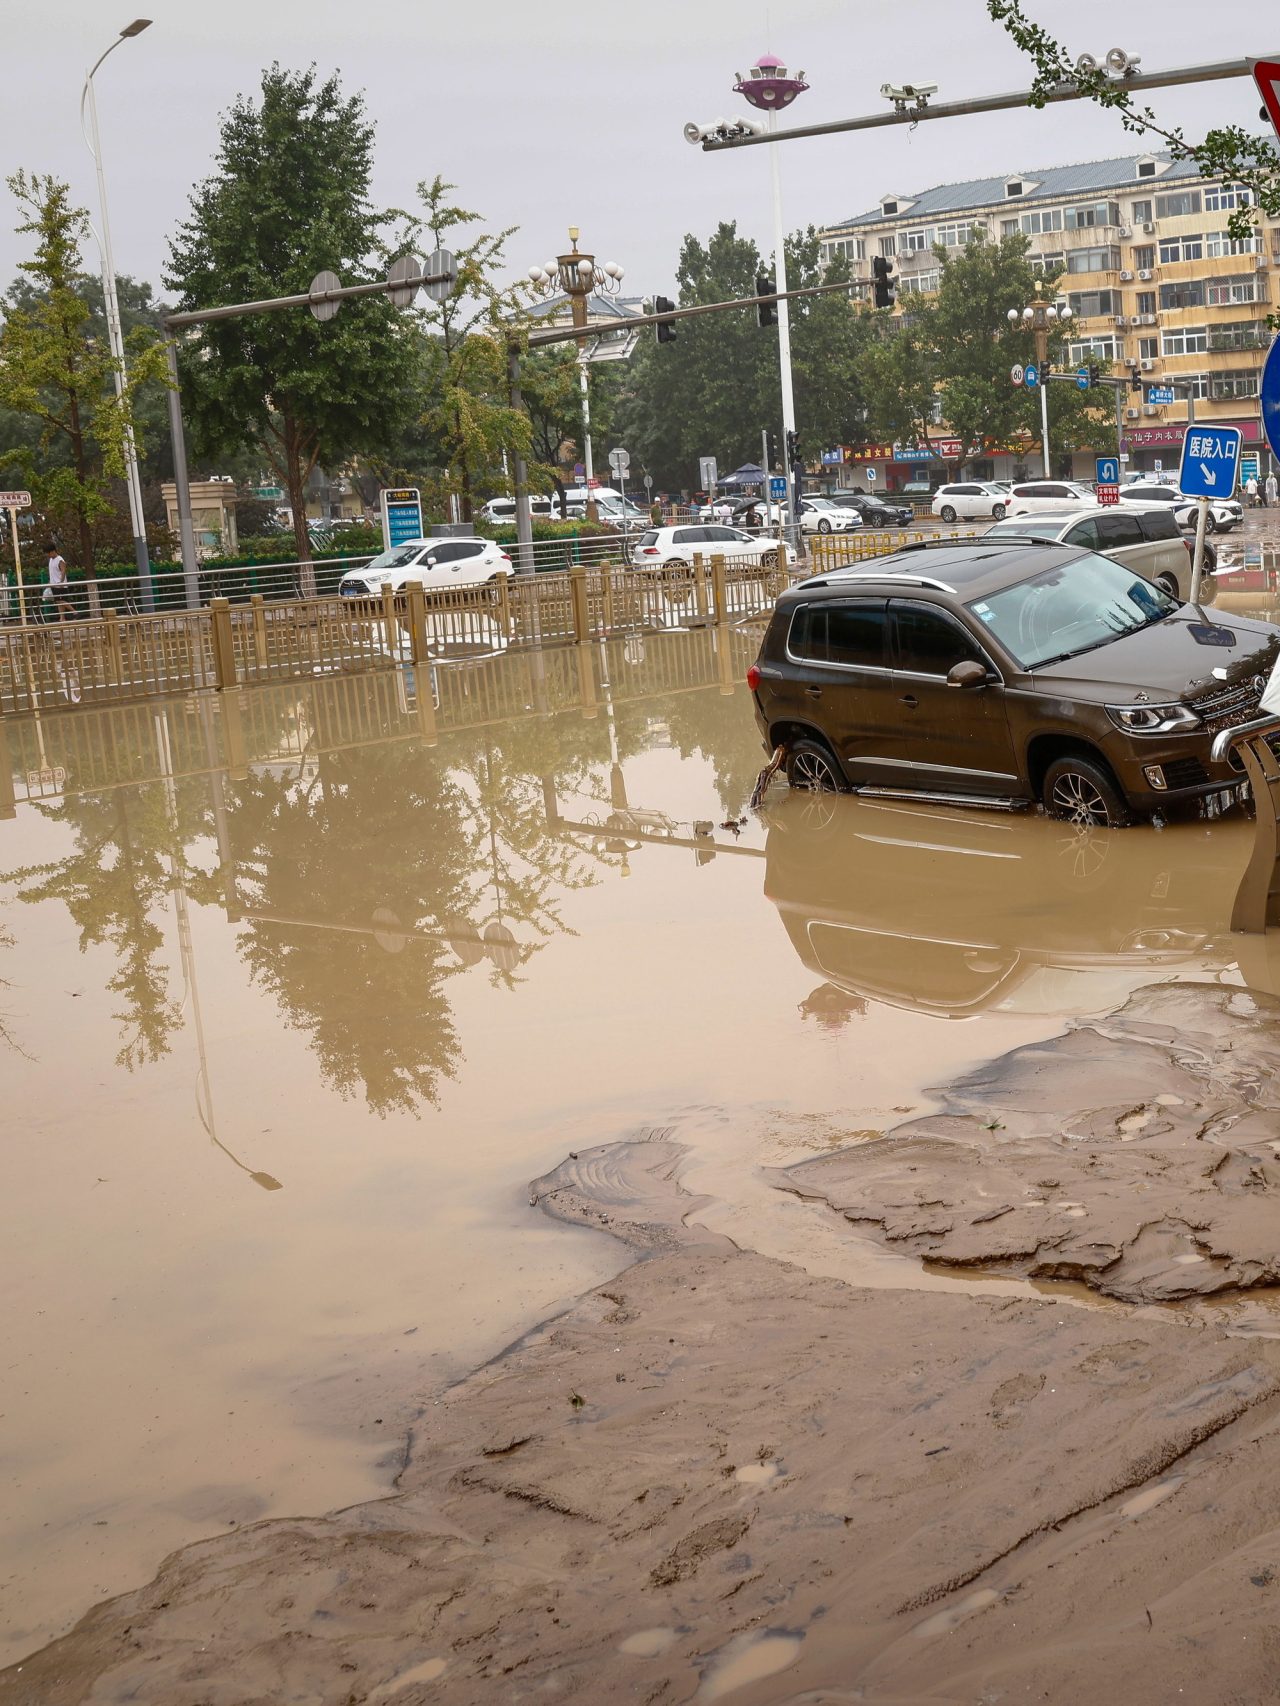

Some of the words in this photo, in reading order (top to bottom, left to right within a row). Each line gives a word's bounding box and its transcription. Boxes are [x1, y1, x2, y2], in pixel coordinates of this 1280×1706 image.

[1013, 369, 1022, 380] 60
[1189, 436, 1236, 459] 医院入口
[1098, 487, 1118, 495] 文明驾驶
